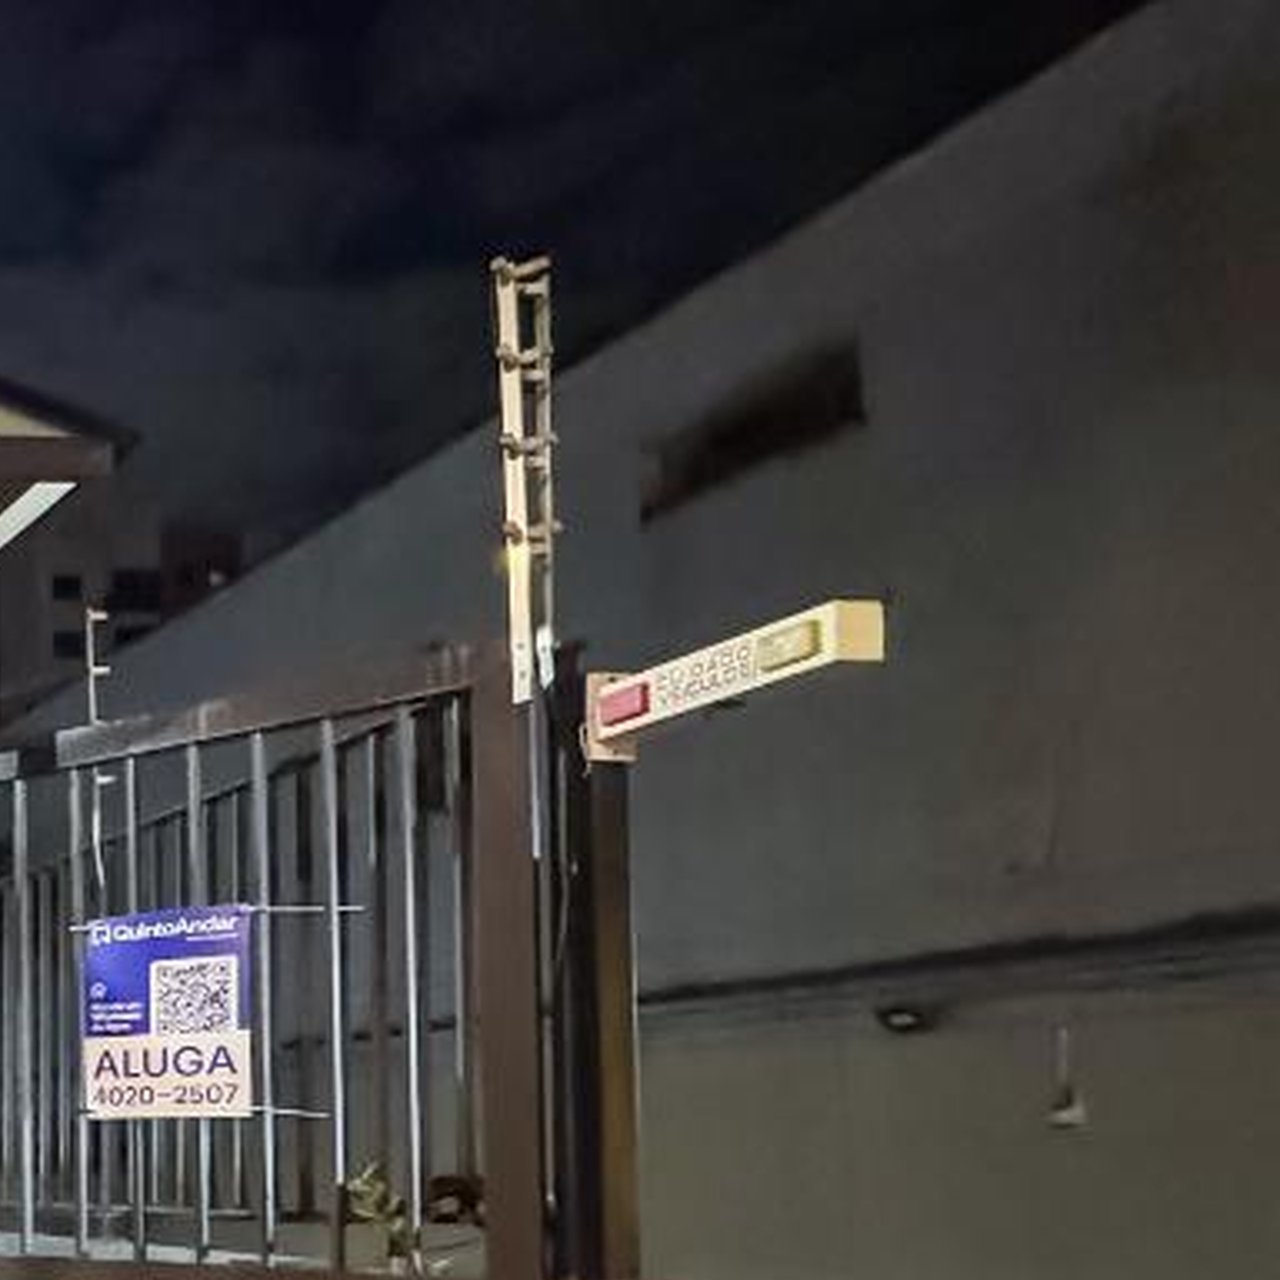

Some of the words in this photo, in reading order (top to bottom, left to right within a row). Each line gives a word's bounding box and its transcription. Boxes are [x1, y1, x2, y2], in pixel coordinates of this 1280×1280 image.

[113, 916, 239, 942] QuintoAndar
[94, 1045, 239, 1079] ALUGA
[94, 1082, 239, 1107] 4020-2507
